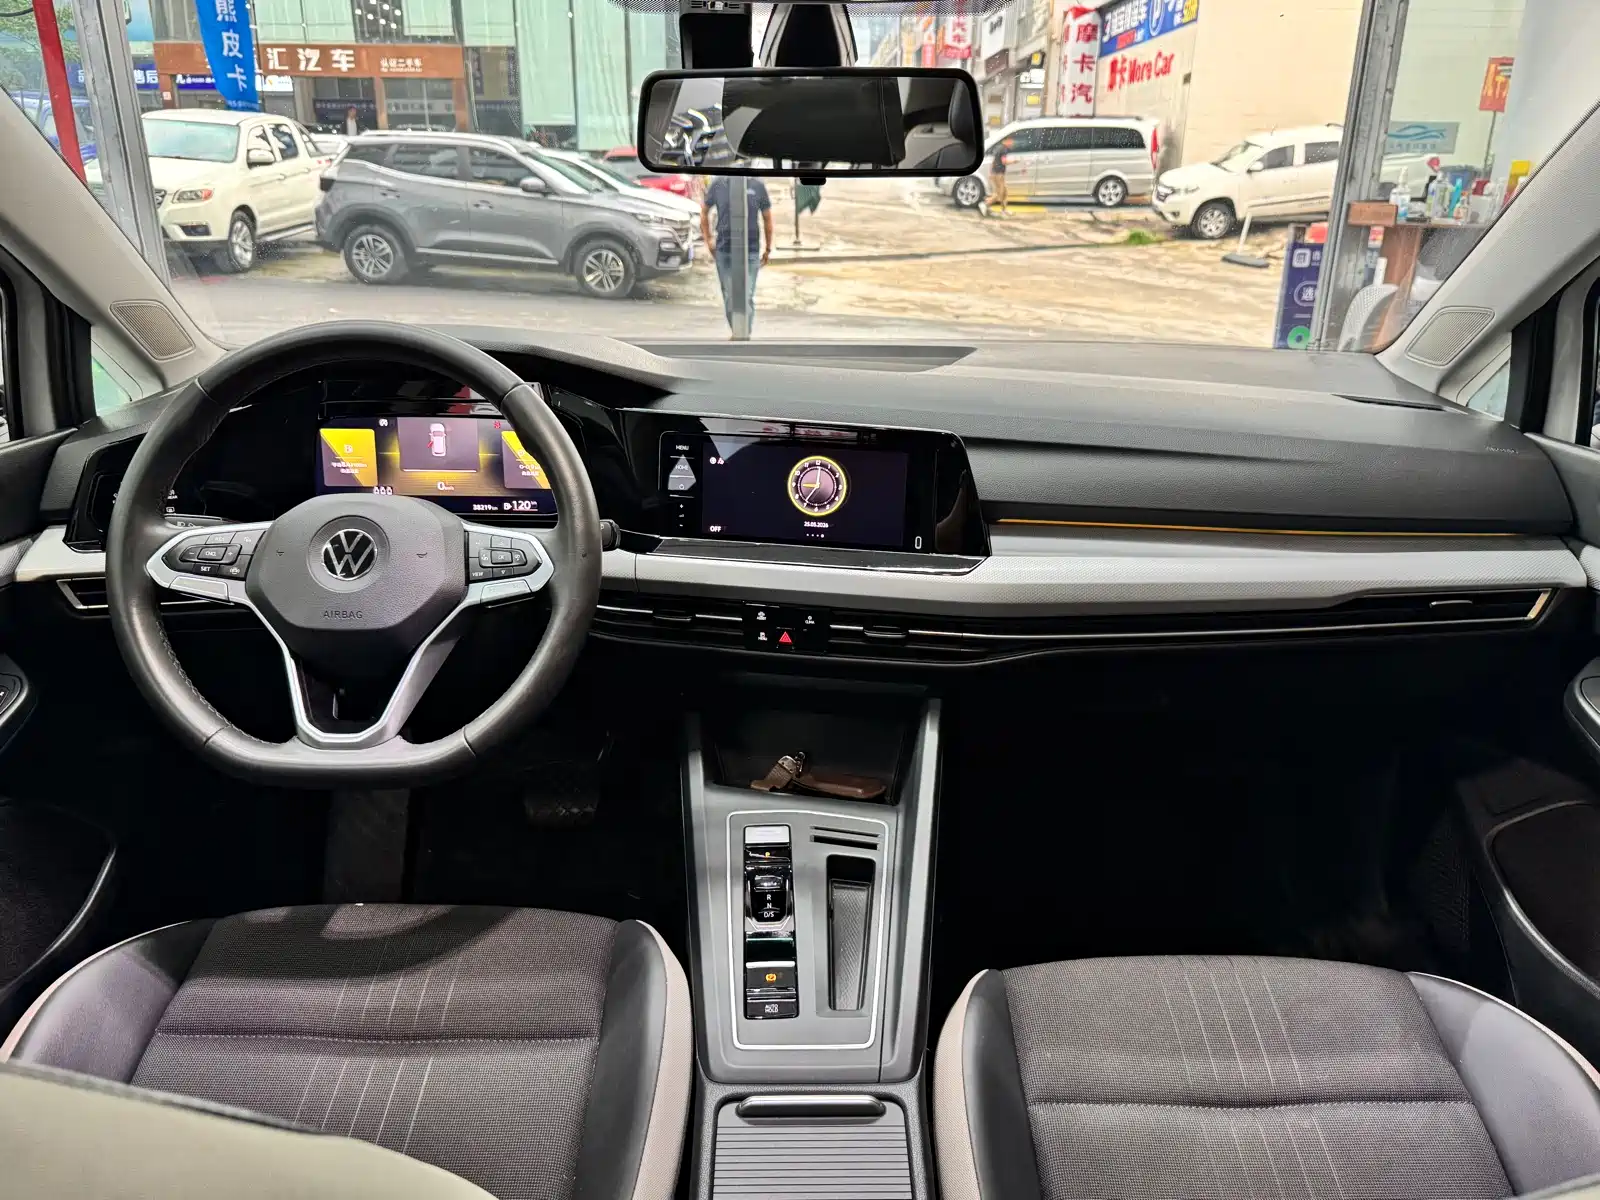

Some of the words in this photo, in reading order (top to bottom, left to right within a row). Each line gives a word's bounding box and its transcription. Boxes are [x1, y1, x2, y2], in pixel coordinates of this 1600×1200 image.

[254, 47, 356, 72] 汇汽车
[1071, 23, 1098, 118] 摩卡汽
[512, 500, 531, 510] 120
[323, 610, 363, 619] AIRBAG
